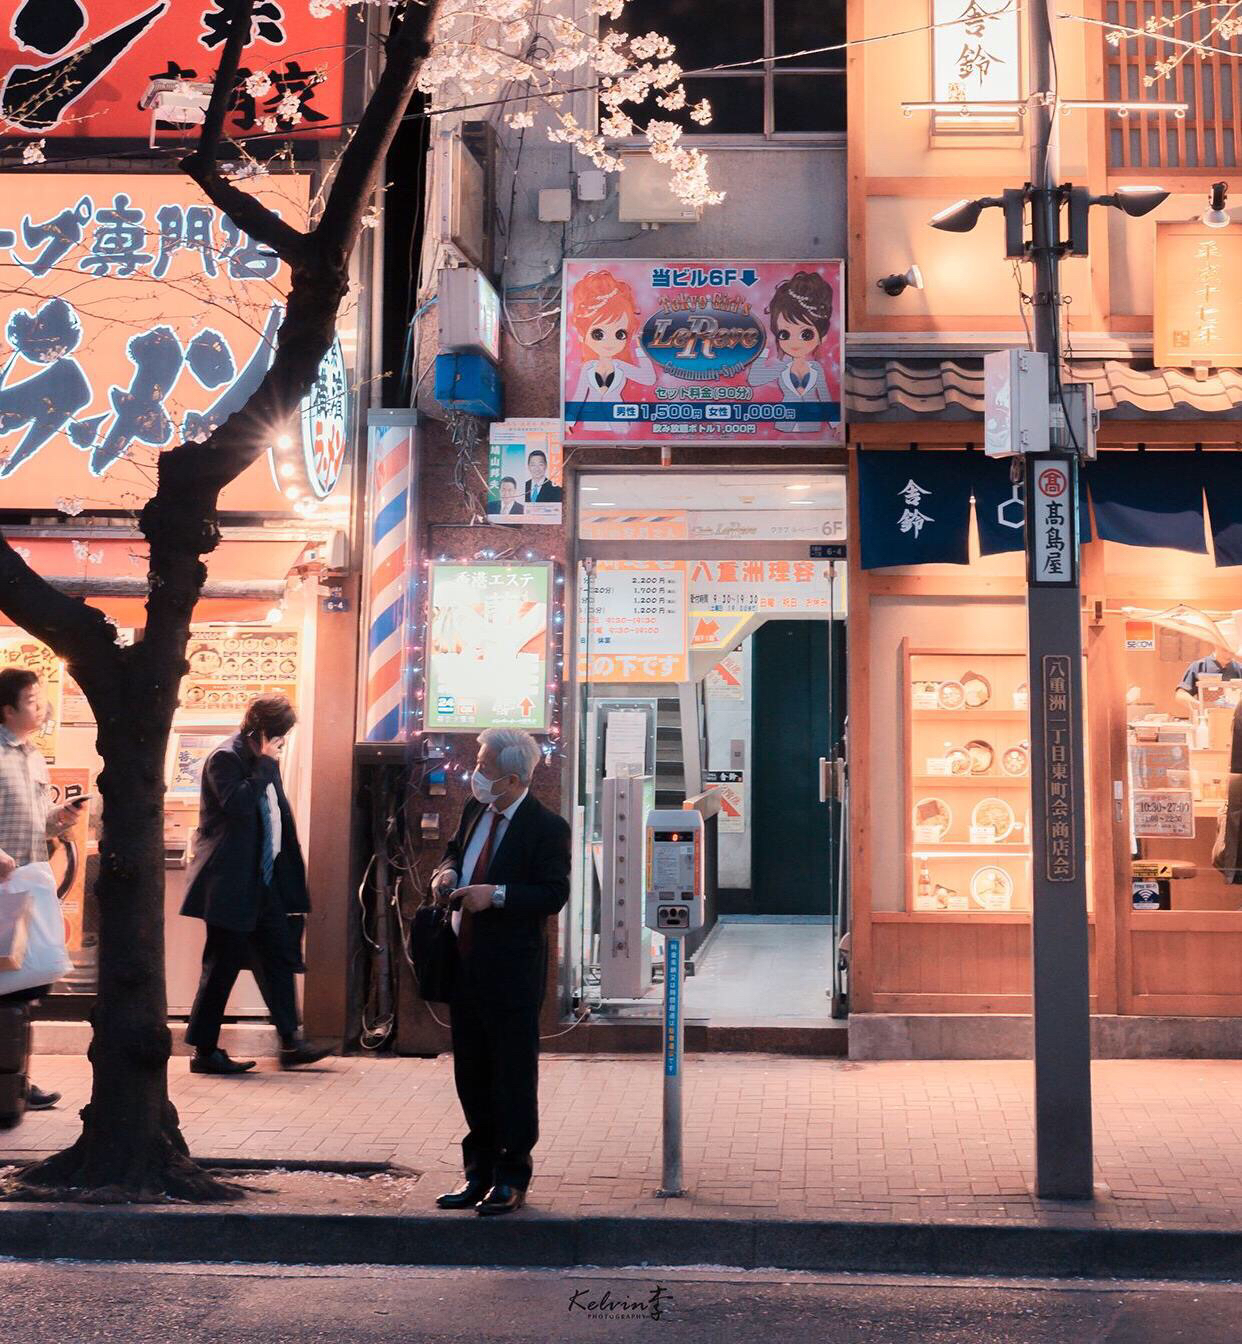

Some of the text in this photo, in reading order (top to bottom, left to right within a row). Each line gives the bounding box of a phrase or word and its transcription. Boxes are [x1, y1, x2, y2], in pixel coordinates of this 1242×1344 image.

[652, 268, 737, 288] 当ビル6F
[822, 522, 843, 536] 6F
[691, 561, 815, 583] 八重洲理容
[1127, 640, 1153, 649] SECOM
